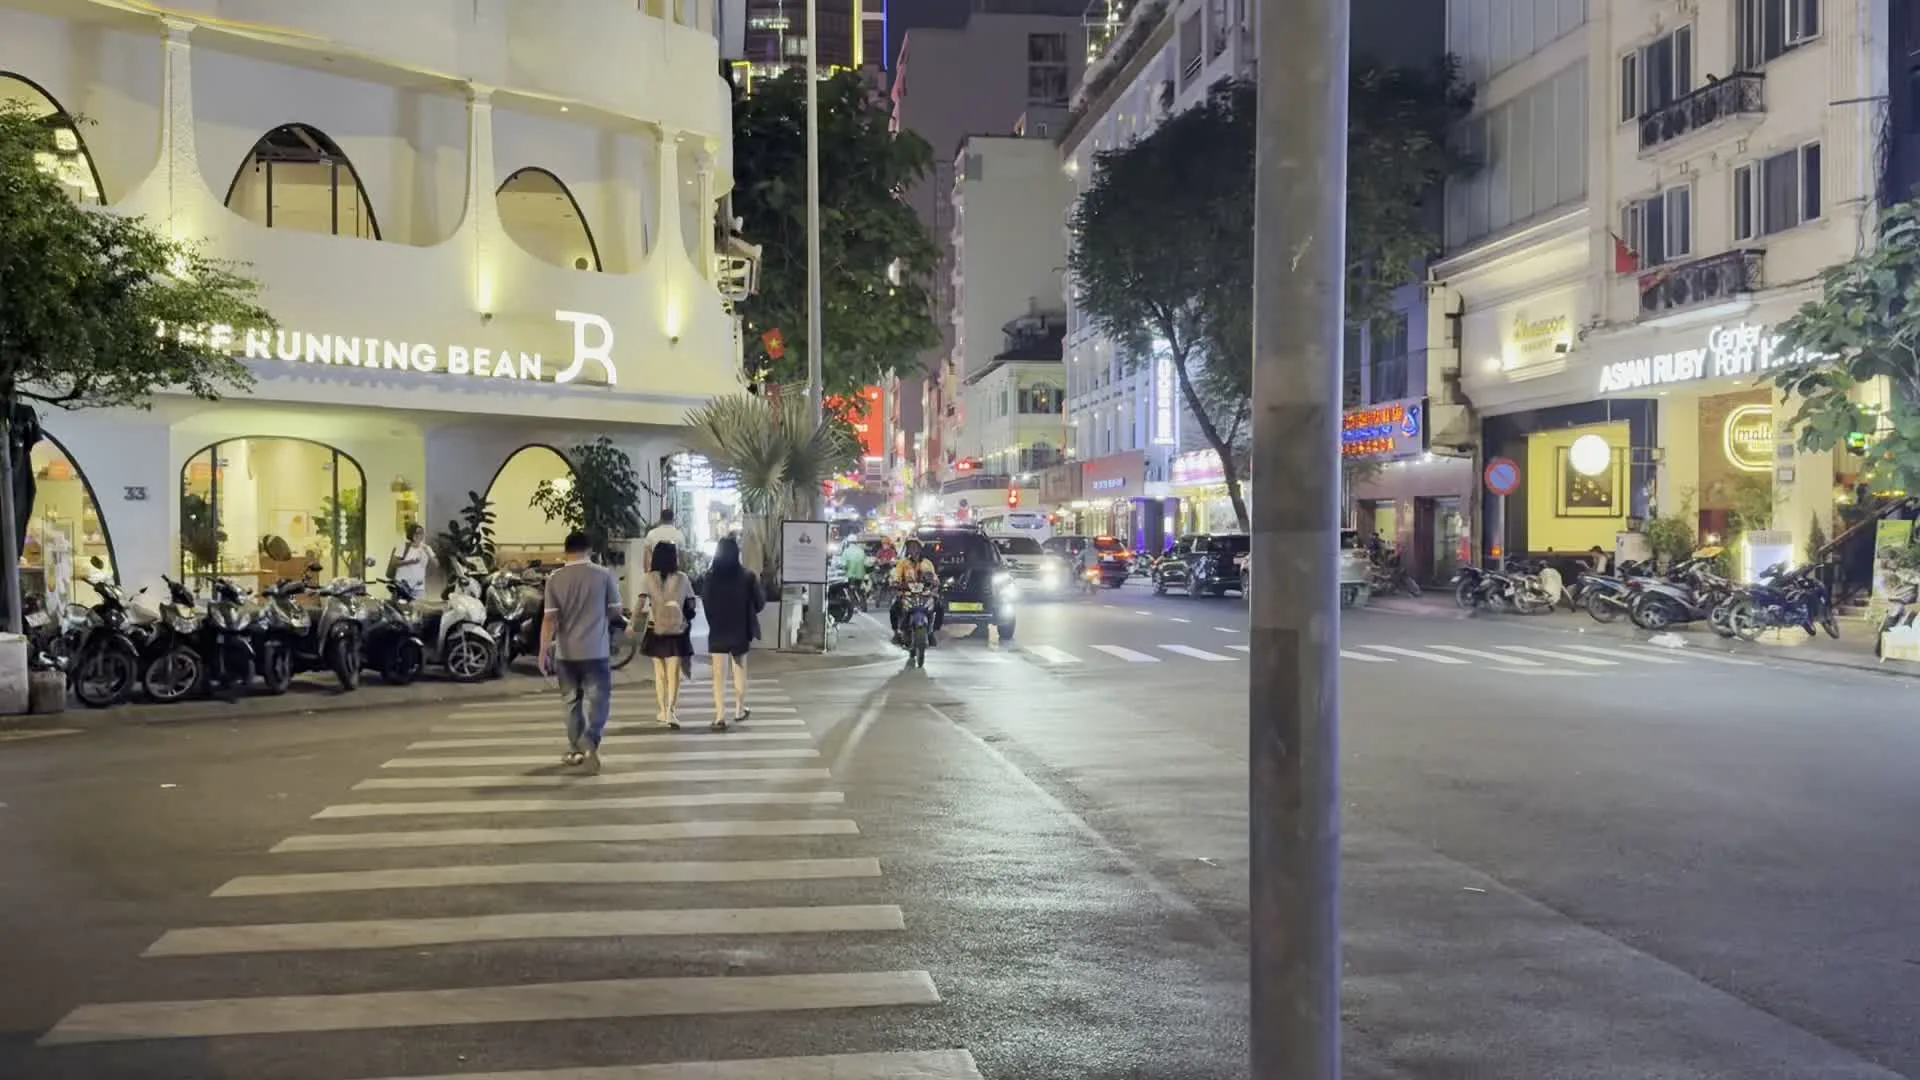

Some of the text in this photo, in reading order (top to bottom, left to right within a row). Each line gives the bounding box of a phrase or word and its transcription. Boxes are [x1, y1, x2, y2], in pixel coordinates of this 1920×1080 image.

[1709, 322, 1762, 353] Center
[246, 327, 437, 372] RUNNING
[448, 344, 542, 380] BEAN
[1715, 347, 1755, 376] Point
[1600, 347, 1708, 393] ASIAN RUBY
[123, 486, 147, 500] 33
